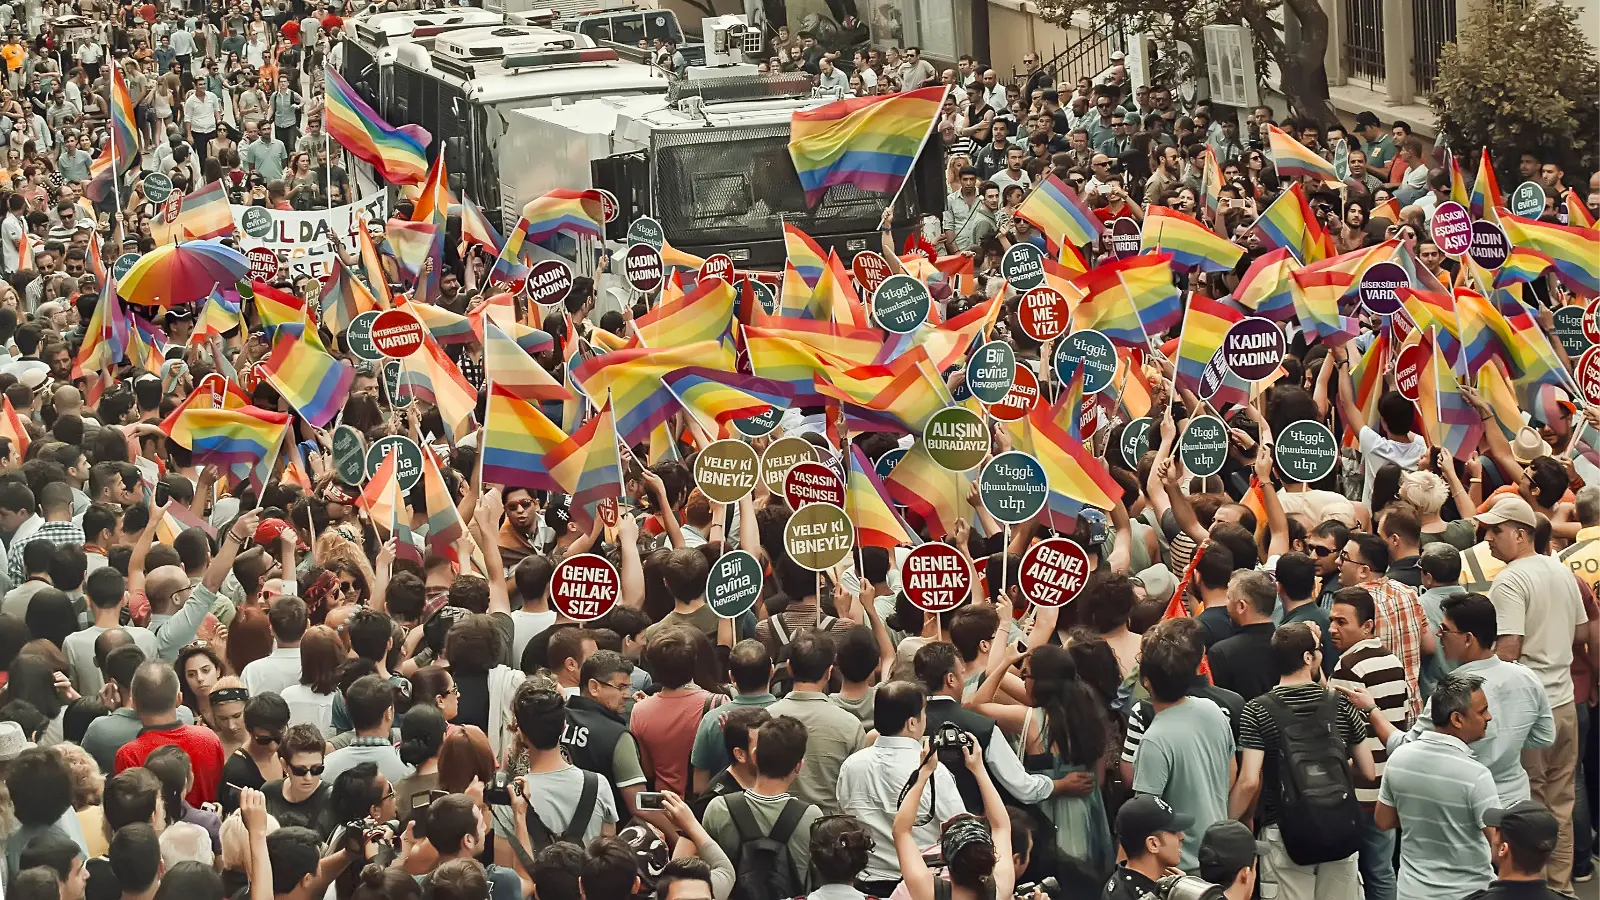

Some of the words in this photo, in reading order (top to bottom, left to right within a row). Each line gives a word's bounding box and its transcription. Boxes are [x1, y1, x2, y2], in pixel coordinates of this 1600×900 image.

[1445, 234, 1468, 250] AŞK!
[248, 252, 275, 263] GENEL
[627, 254, 659, 268] KADIN
[529, 265, 566, 289] KADIN
[629, 268, 661, 281] KADINA
[532, 277, 570, 300] KADINA
[1366, 290, 1397, 300] VARD
[1027, 291, 1062, 308] DÖN-
[1033, 307, 1058, 322] ME-
[1558, 315, 1582, 327] Կեցց
[378, 332, 420, 349] VARDIR
[1229, 332, 1277, 350] KADIN
[1228, 350, 1280, 367] KADINA
[976, 365, 1008, 379] evîna
[932, 422, 982, 440] ALIŞIN
[928, 438, 987, 451] BURADAYIZ
[704, 456, 736, 469] VELEV
[767, 454, 797, 468] VELEV
[698, 467, 753, 488] İBNEYİZ
[793, 470, 837, 487] YAŞASIN
[789, 483, 840, 502] EŞCİNSEL
[999, 496, 1026, 514] սեր
[792, 523, 828, 537] VELEV
[790, 533, 849, 555] İBNEYİZ
[909, 555, 962, 572] GENEL
[1036, 545, 1084, 576] GENEL
[562, 564, 612, 584] GENEL
[909, 573, 968, 589] AHLAK-
[1027, 563, 1081, 592] AHLAK-
[558, 582, 615, 601] AHLAK-
[715, 573, 751, 597] evîna
[1030, 582, 1063, 605] SIZ!
[922, 590, 954, 607] SIZ!
[568, 600, 599, 616] SIZ!
